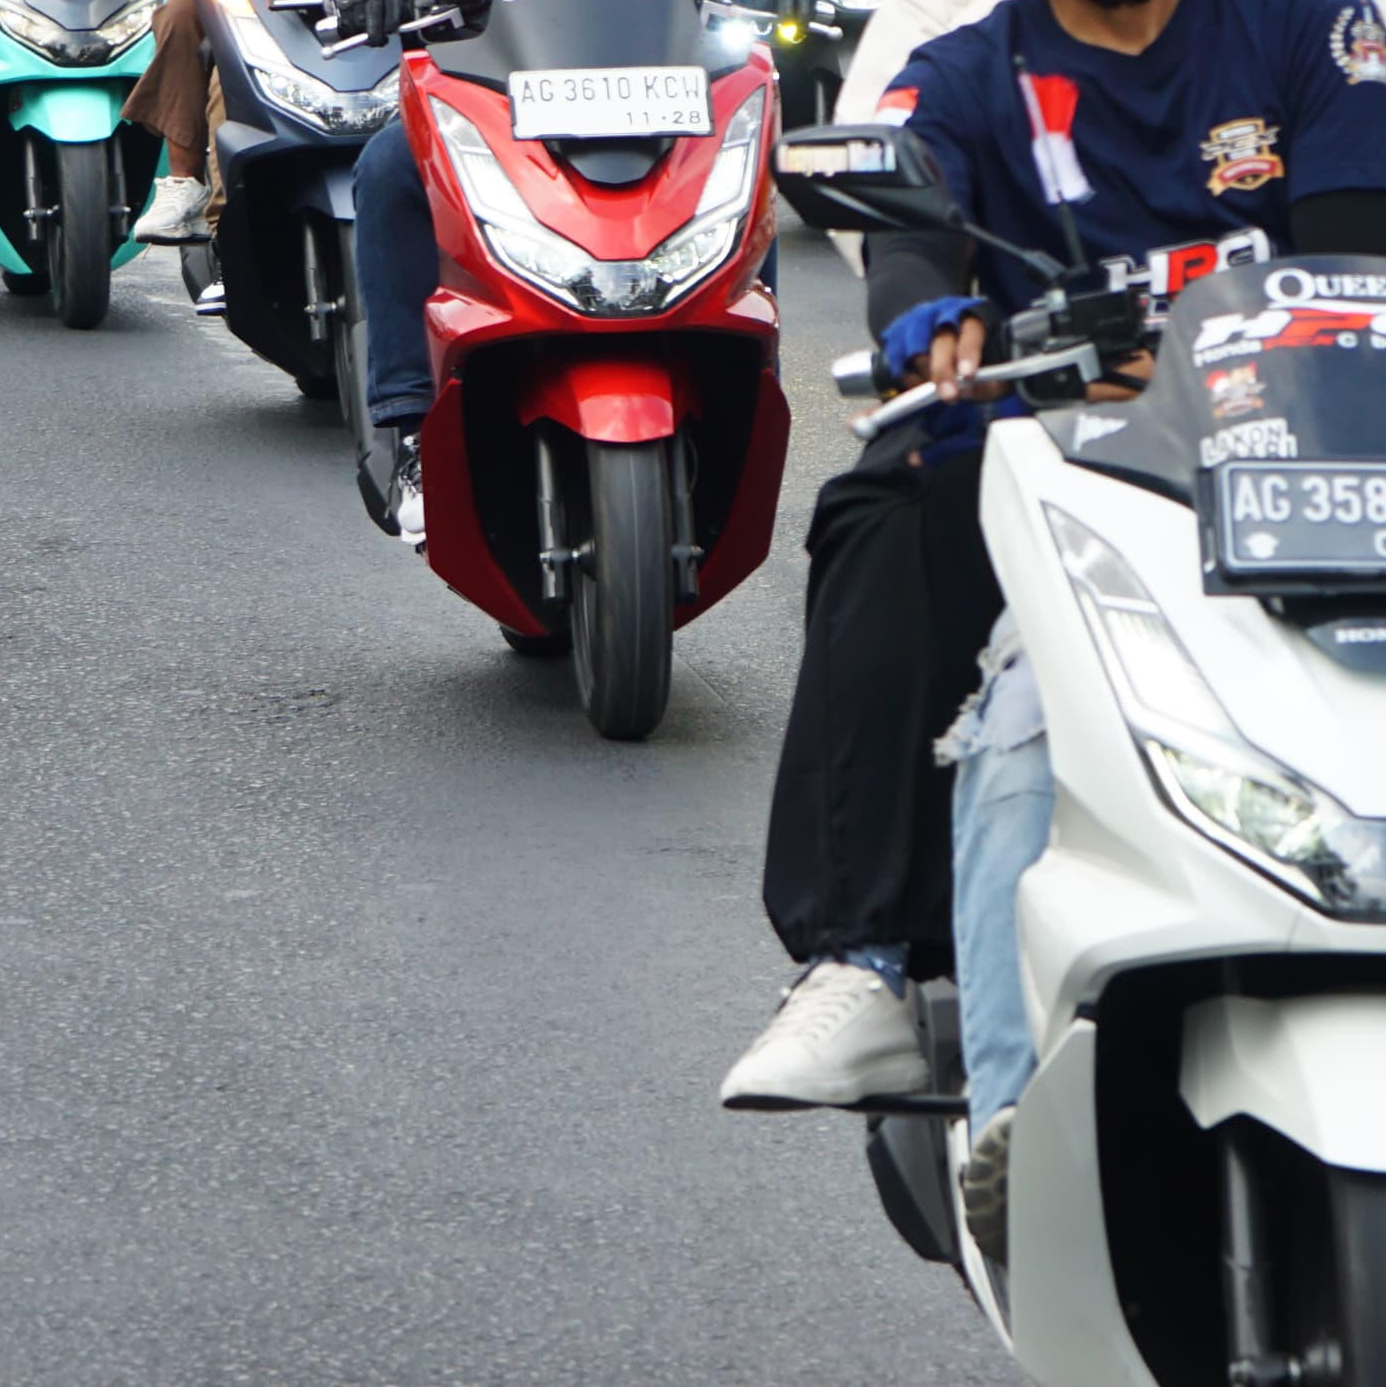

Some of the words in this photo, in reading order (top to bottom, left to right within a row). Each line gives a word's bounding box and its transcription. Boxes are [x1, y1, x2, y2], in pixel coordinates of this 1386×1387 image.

[521, 78, 555, 103] AG
[564, 77, 631, 102] 3610
[643, 75, 700, 100] KCW
[1234, 474, 1291, 521] AG
